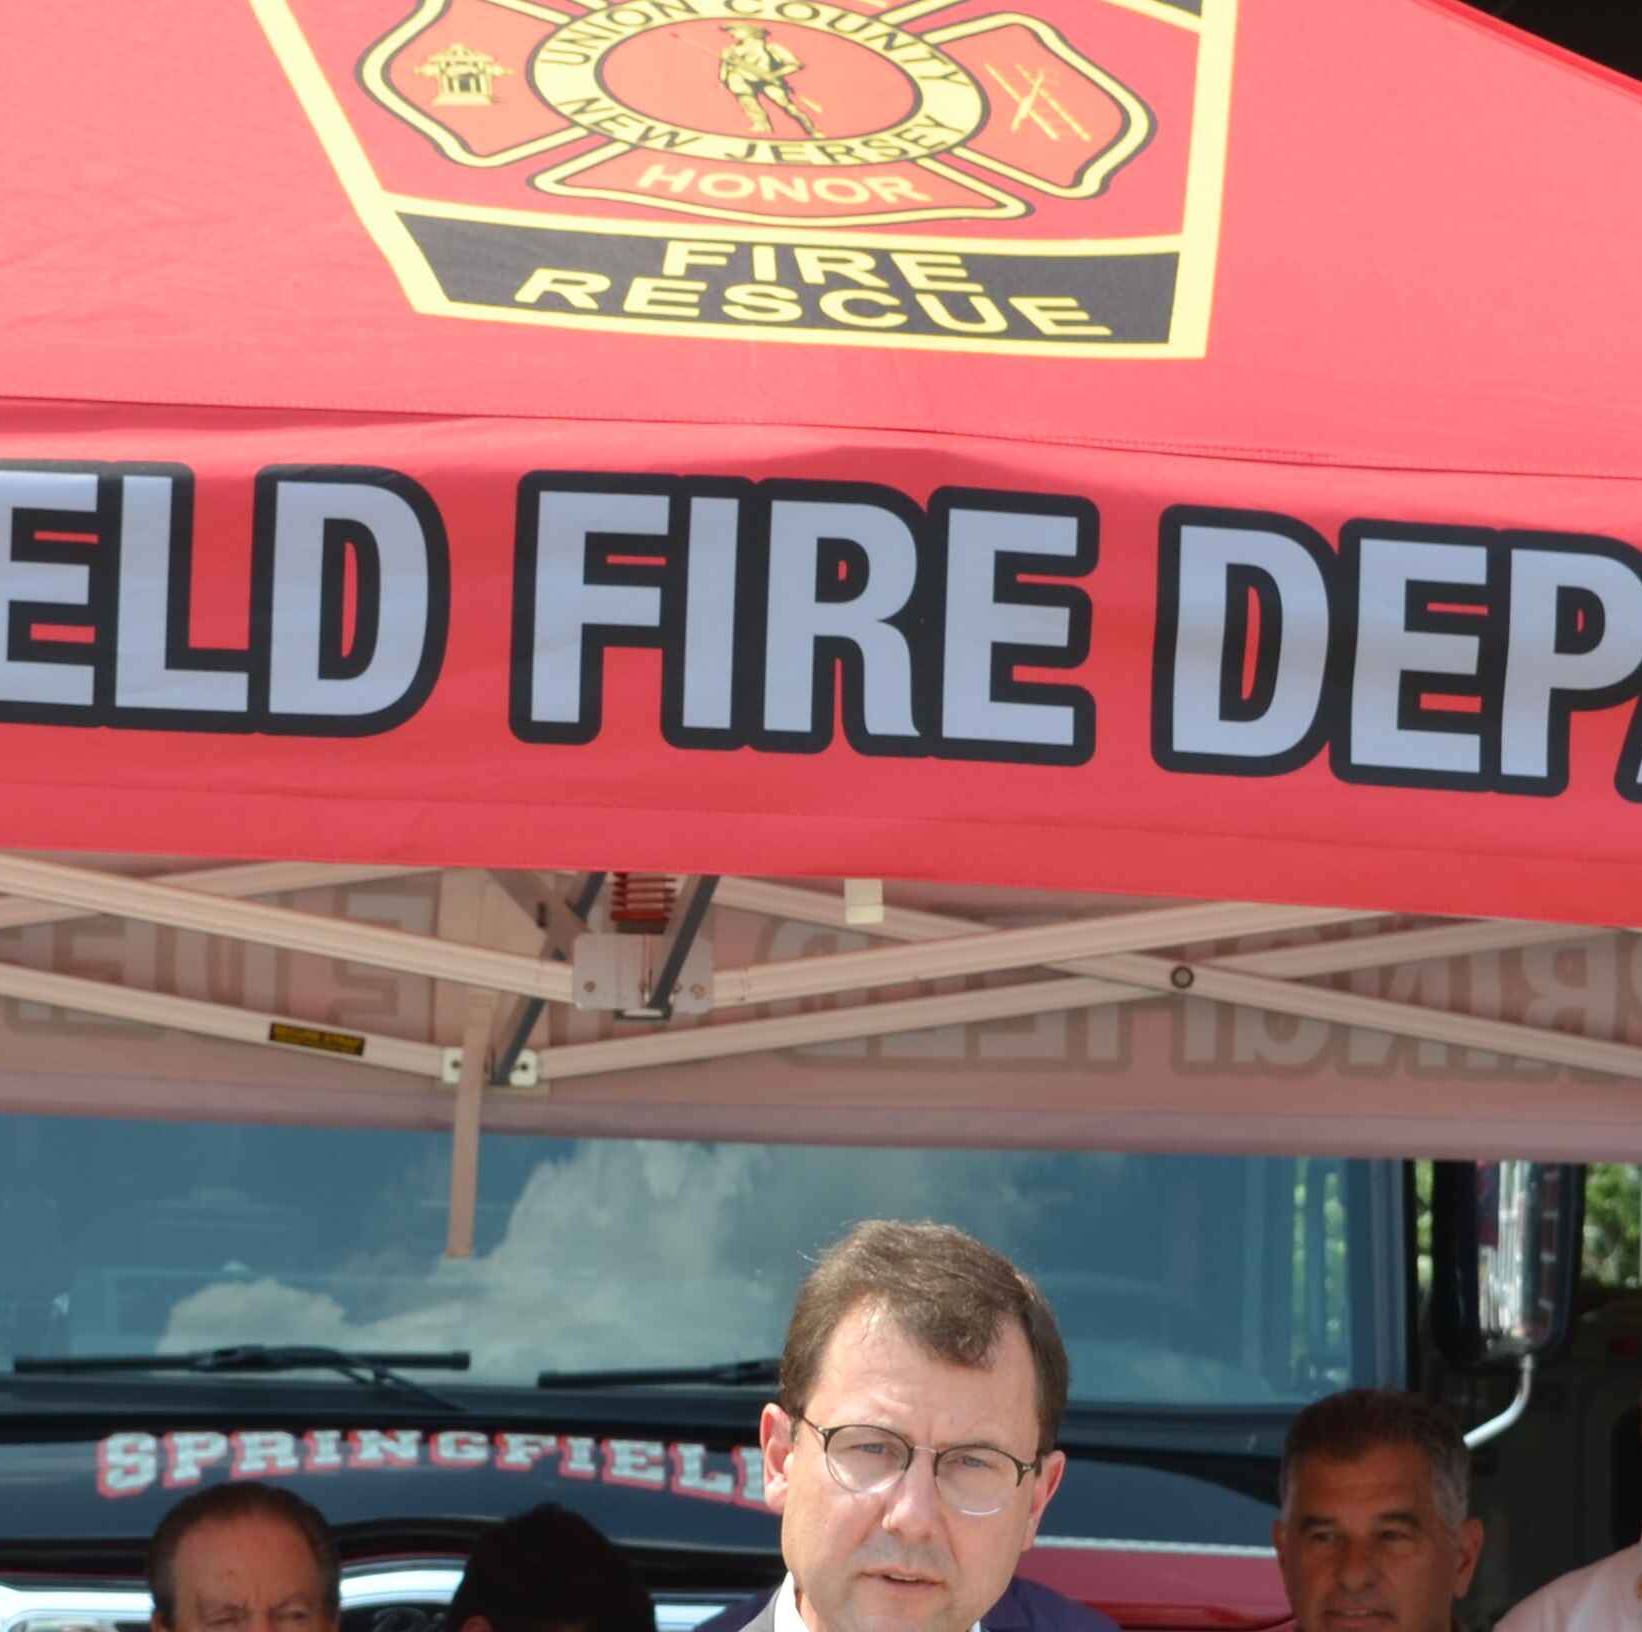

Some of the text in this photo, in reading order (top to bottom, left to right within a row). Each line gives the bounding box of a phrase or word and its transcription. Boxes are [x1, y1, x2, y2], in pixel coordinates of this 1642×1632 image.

[540, 0, 973, 88] UNION COUNTY
[557, 95, 965, 165] NEW JERSEY
[636, 163, 934, 205] HONOR
[661, 240, 985, 293] FIRE
[513, 267, 1113, 337] RESCUE
[521, 482, 1088, 755] FIRE
